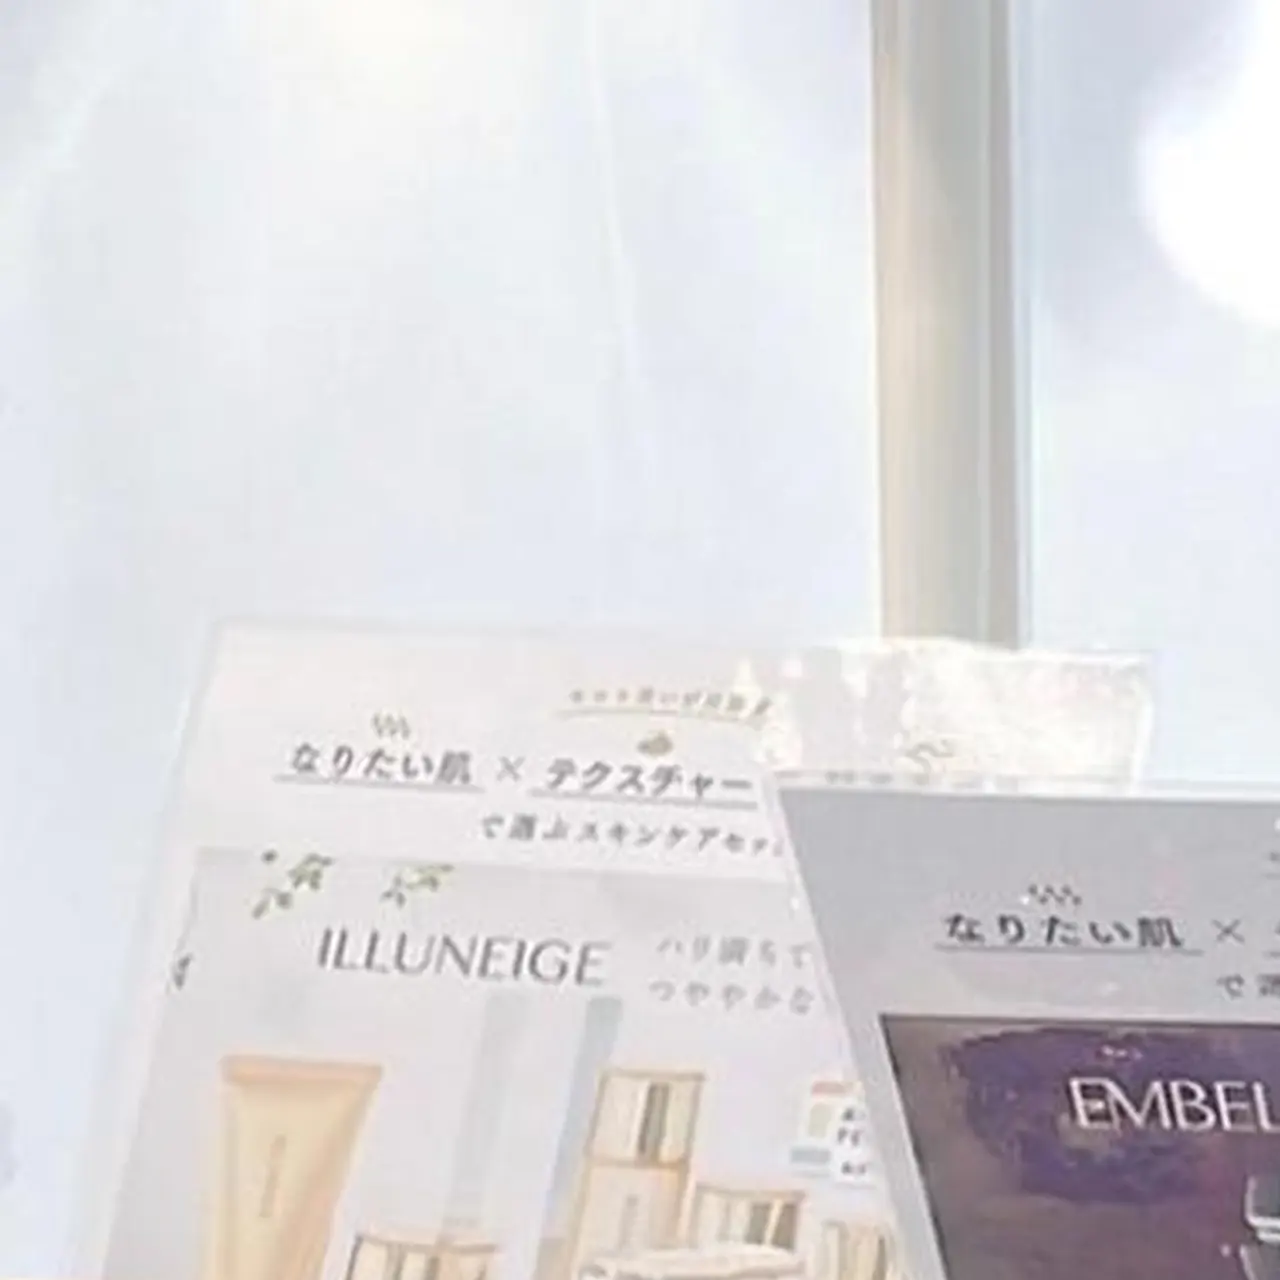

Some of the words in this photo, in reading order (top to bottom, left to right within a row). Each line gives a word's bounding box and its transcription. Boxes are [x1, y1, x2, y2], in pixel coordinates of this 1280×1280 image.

[291, 744, 473, 784] なりたい肌
[545, 757, 753, 797] テクスチャー
[316, 926, 611, 986] ILLUNEIGE
[943, 914, 1184, 948] なりたい肌
